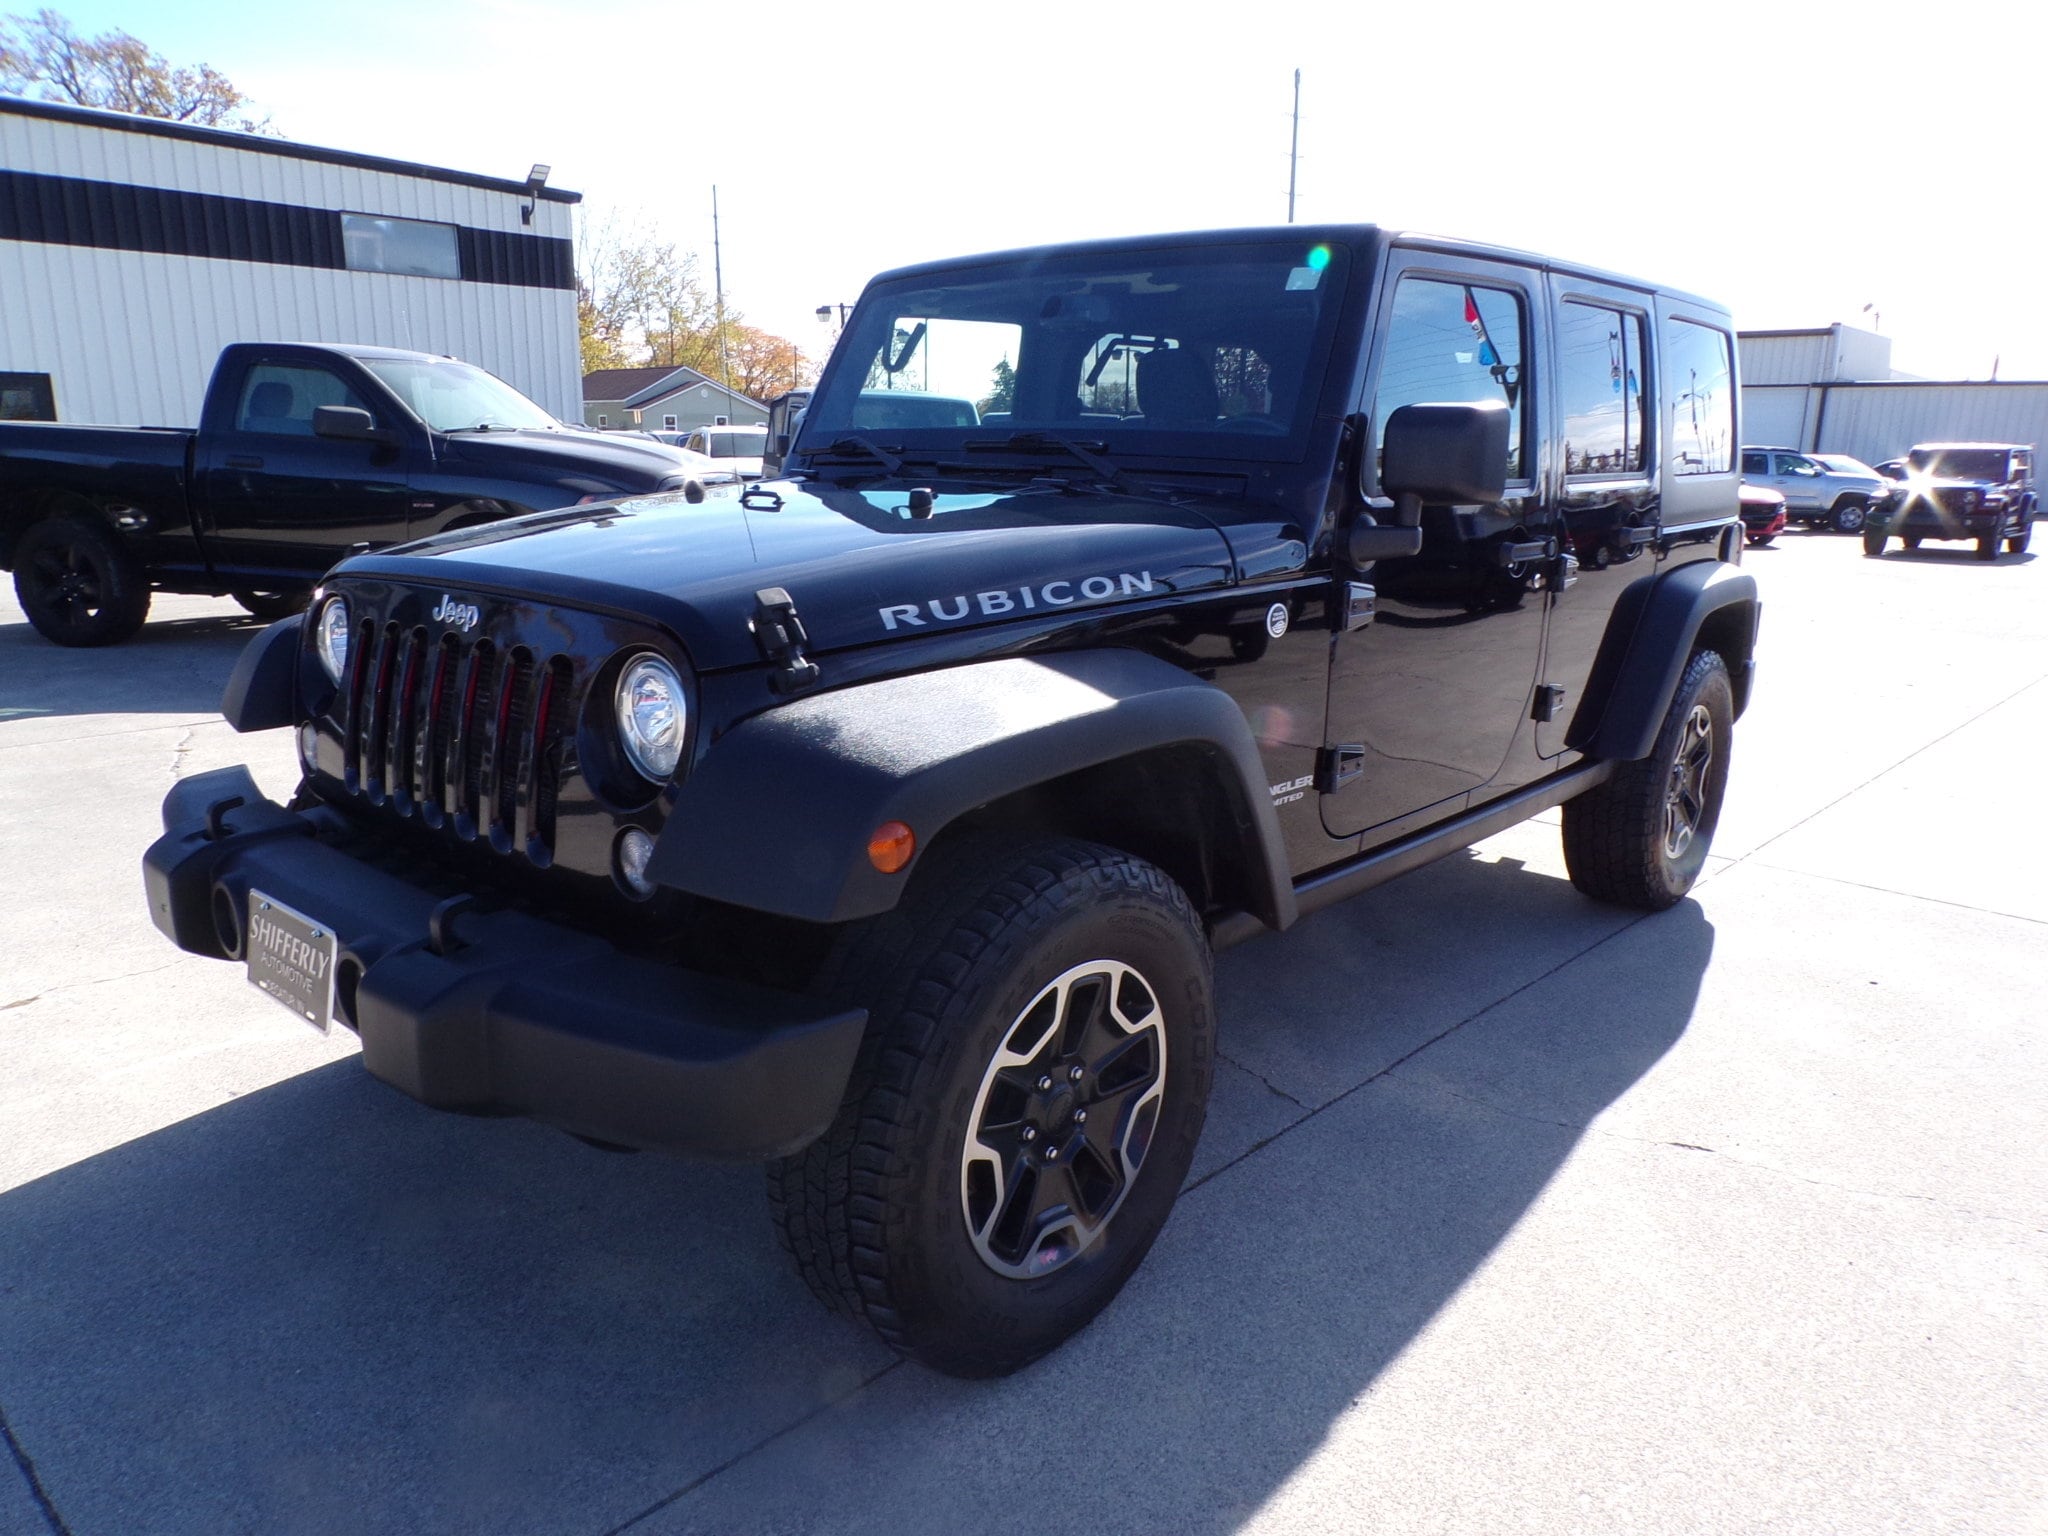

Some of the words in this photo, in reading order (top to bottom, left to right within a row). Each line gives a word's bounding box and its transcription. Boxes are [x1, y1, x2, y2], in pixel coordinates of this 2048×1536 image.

[432, 594, 479, 632] Jeep
[878, 570, 1154, 630] RUBICON
[1269, 774, 1314, 796] NGLER
[250, 914, 330, 980] SHIFFERLY
